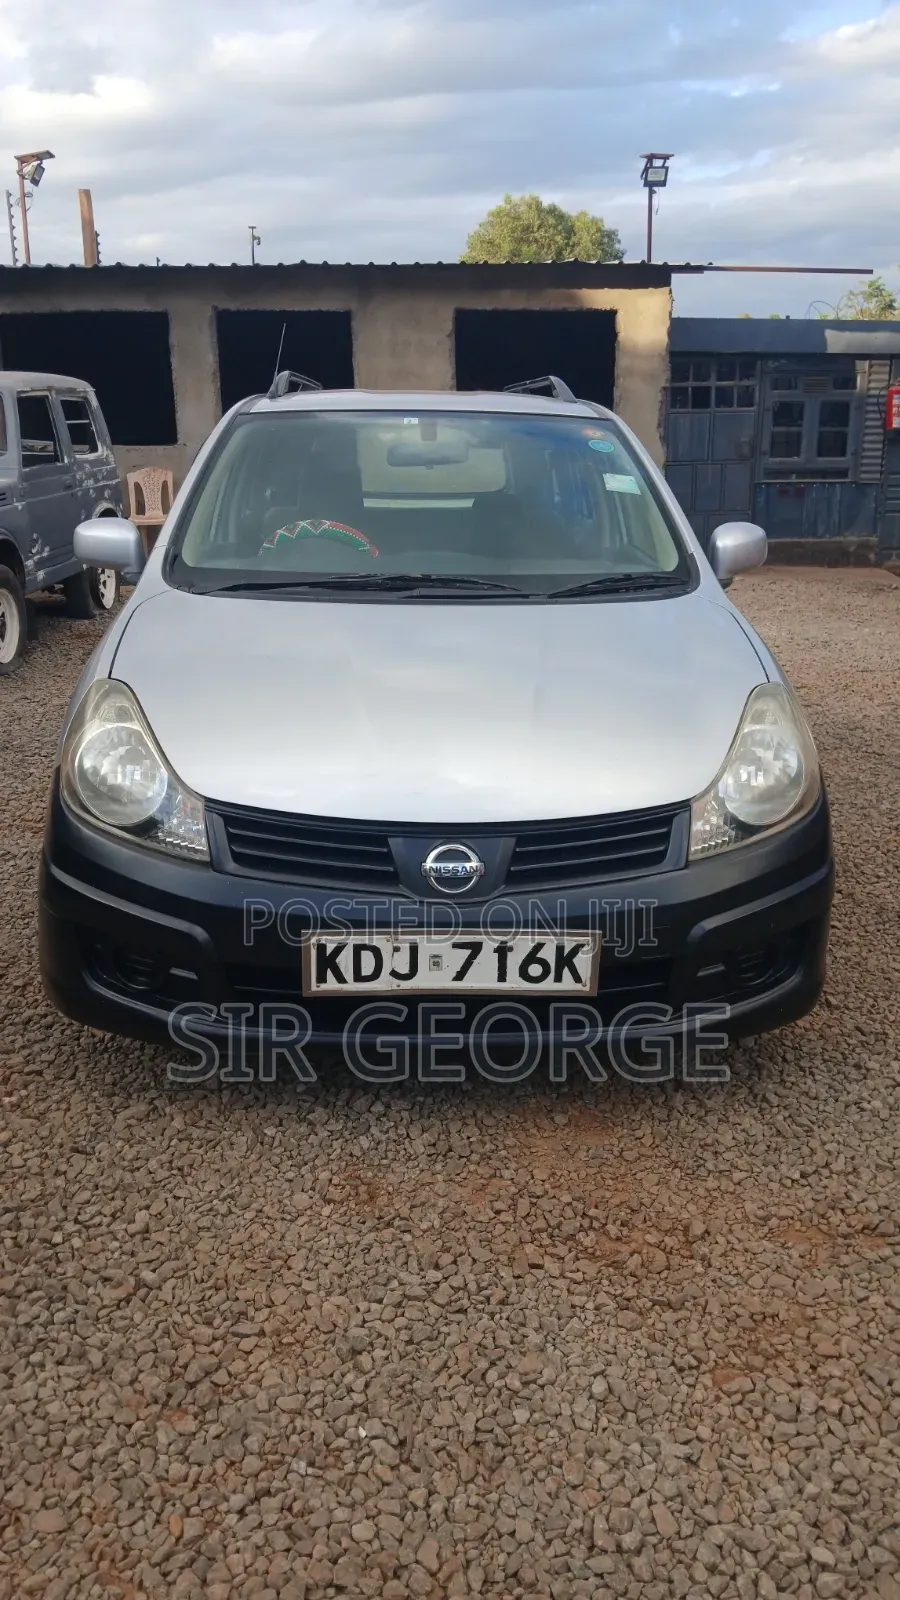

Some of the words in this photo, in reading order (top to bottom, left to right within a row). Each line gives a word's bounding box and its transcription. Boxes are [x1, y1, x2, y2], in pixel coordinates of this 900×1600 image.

[428, 865, 478, 874] NISSAN
[315, 941, 419, 984] KDJ
[451, 941, 587, 984] 716K
